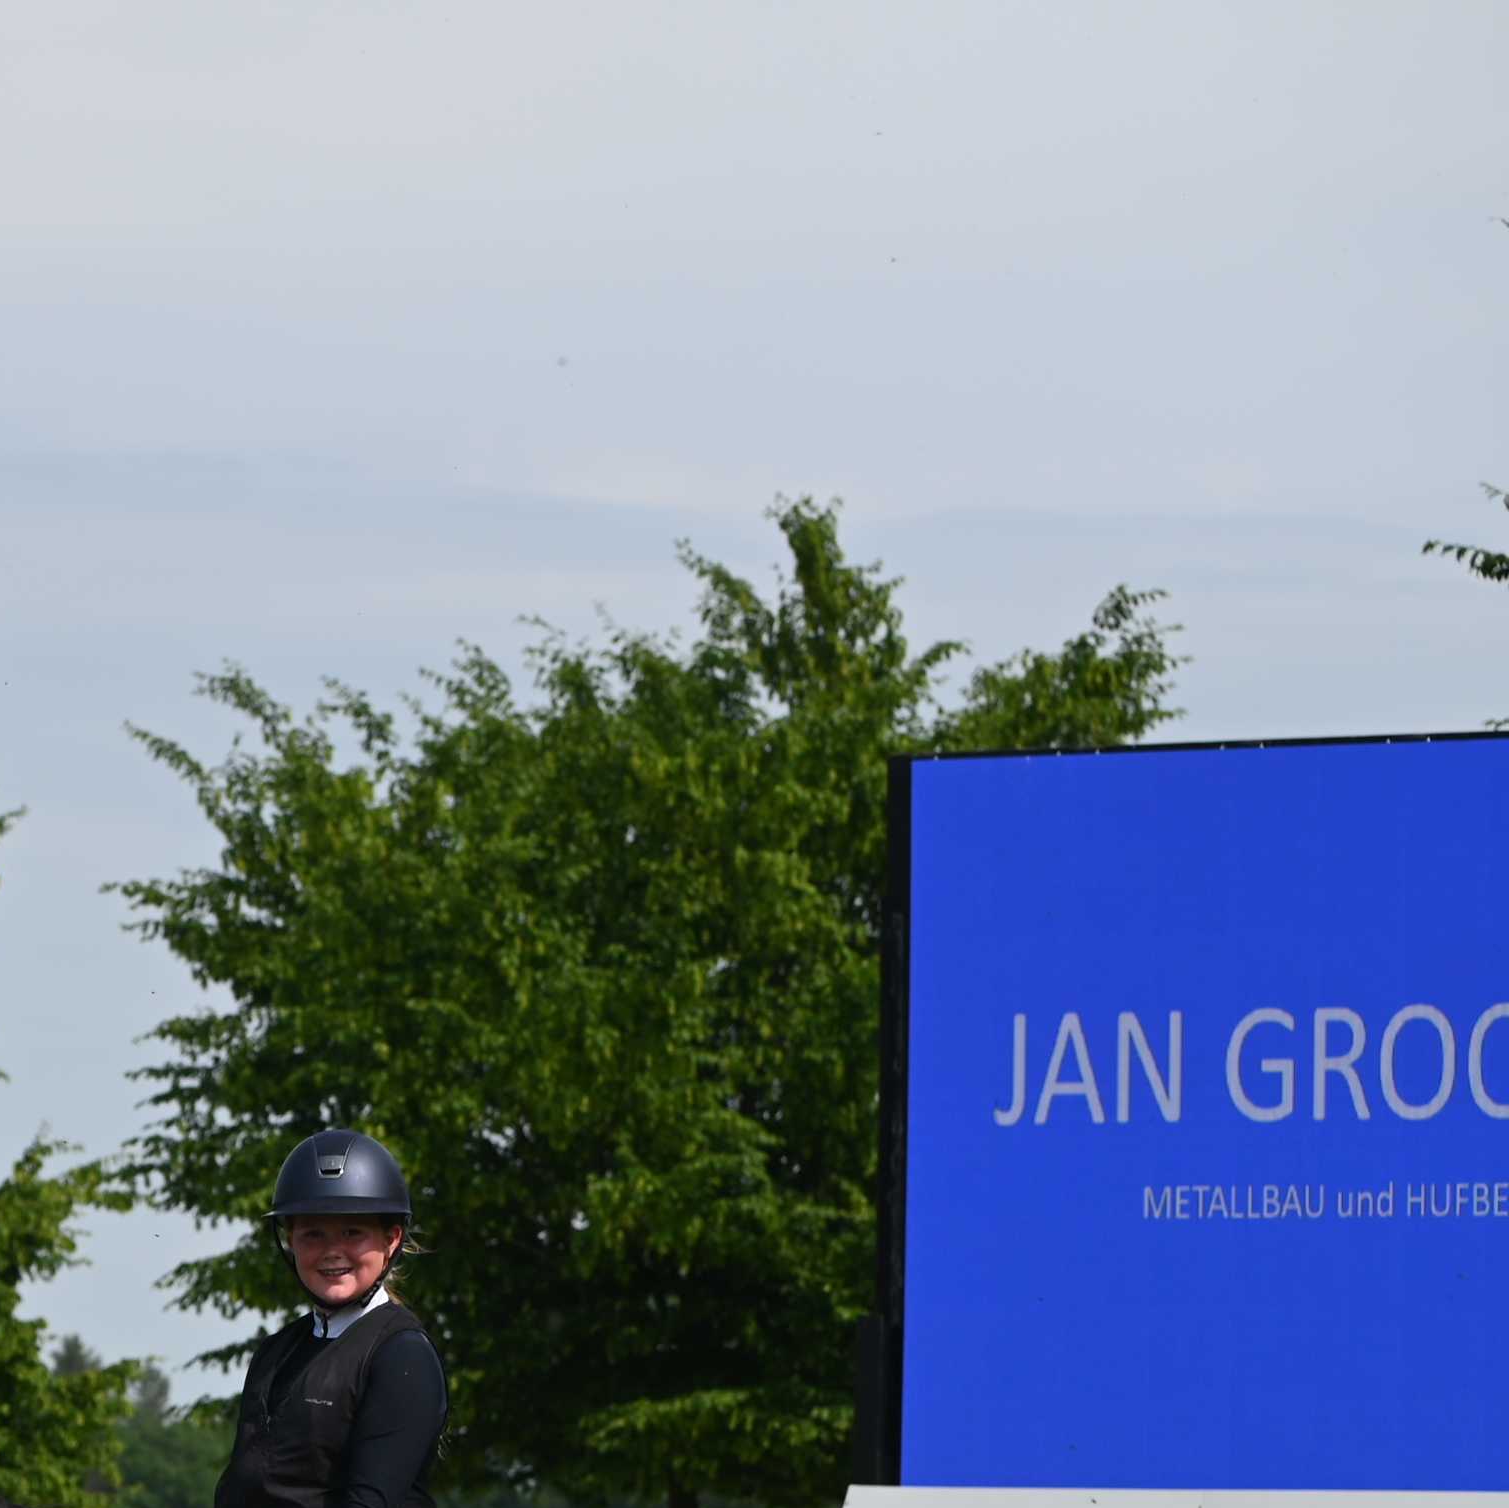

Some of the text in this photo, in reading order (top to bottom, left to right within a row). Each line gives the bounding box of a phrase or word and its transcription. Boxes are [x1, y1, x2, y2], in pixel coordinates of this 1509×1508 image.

[994, 1010, 1182, 1126] JAN
[1143, 1181, 1509, 1219] METALLBAU und HUFBE
